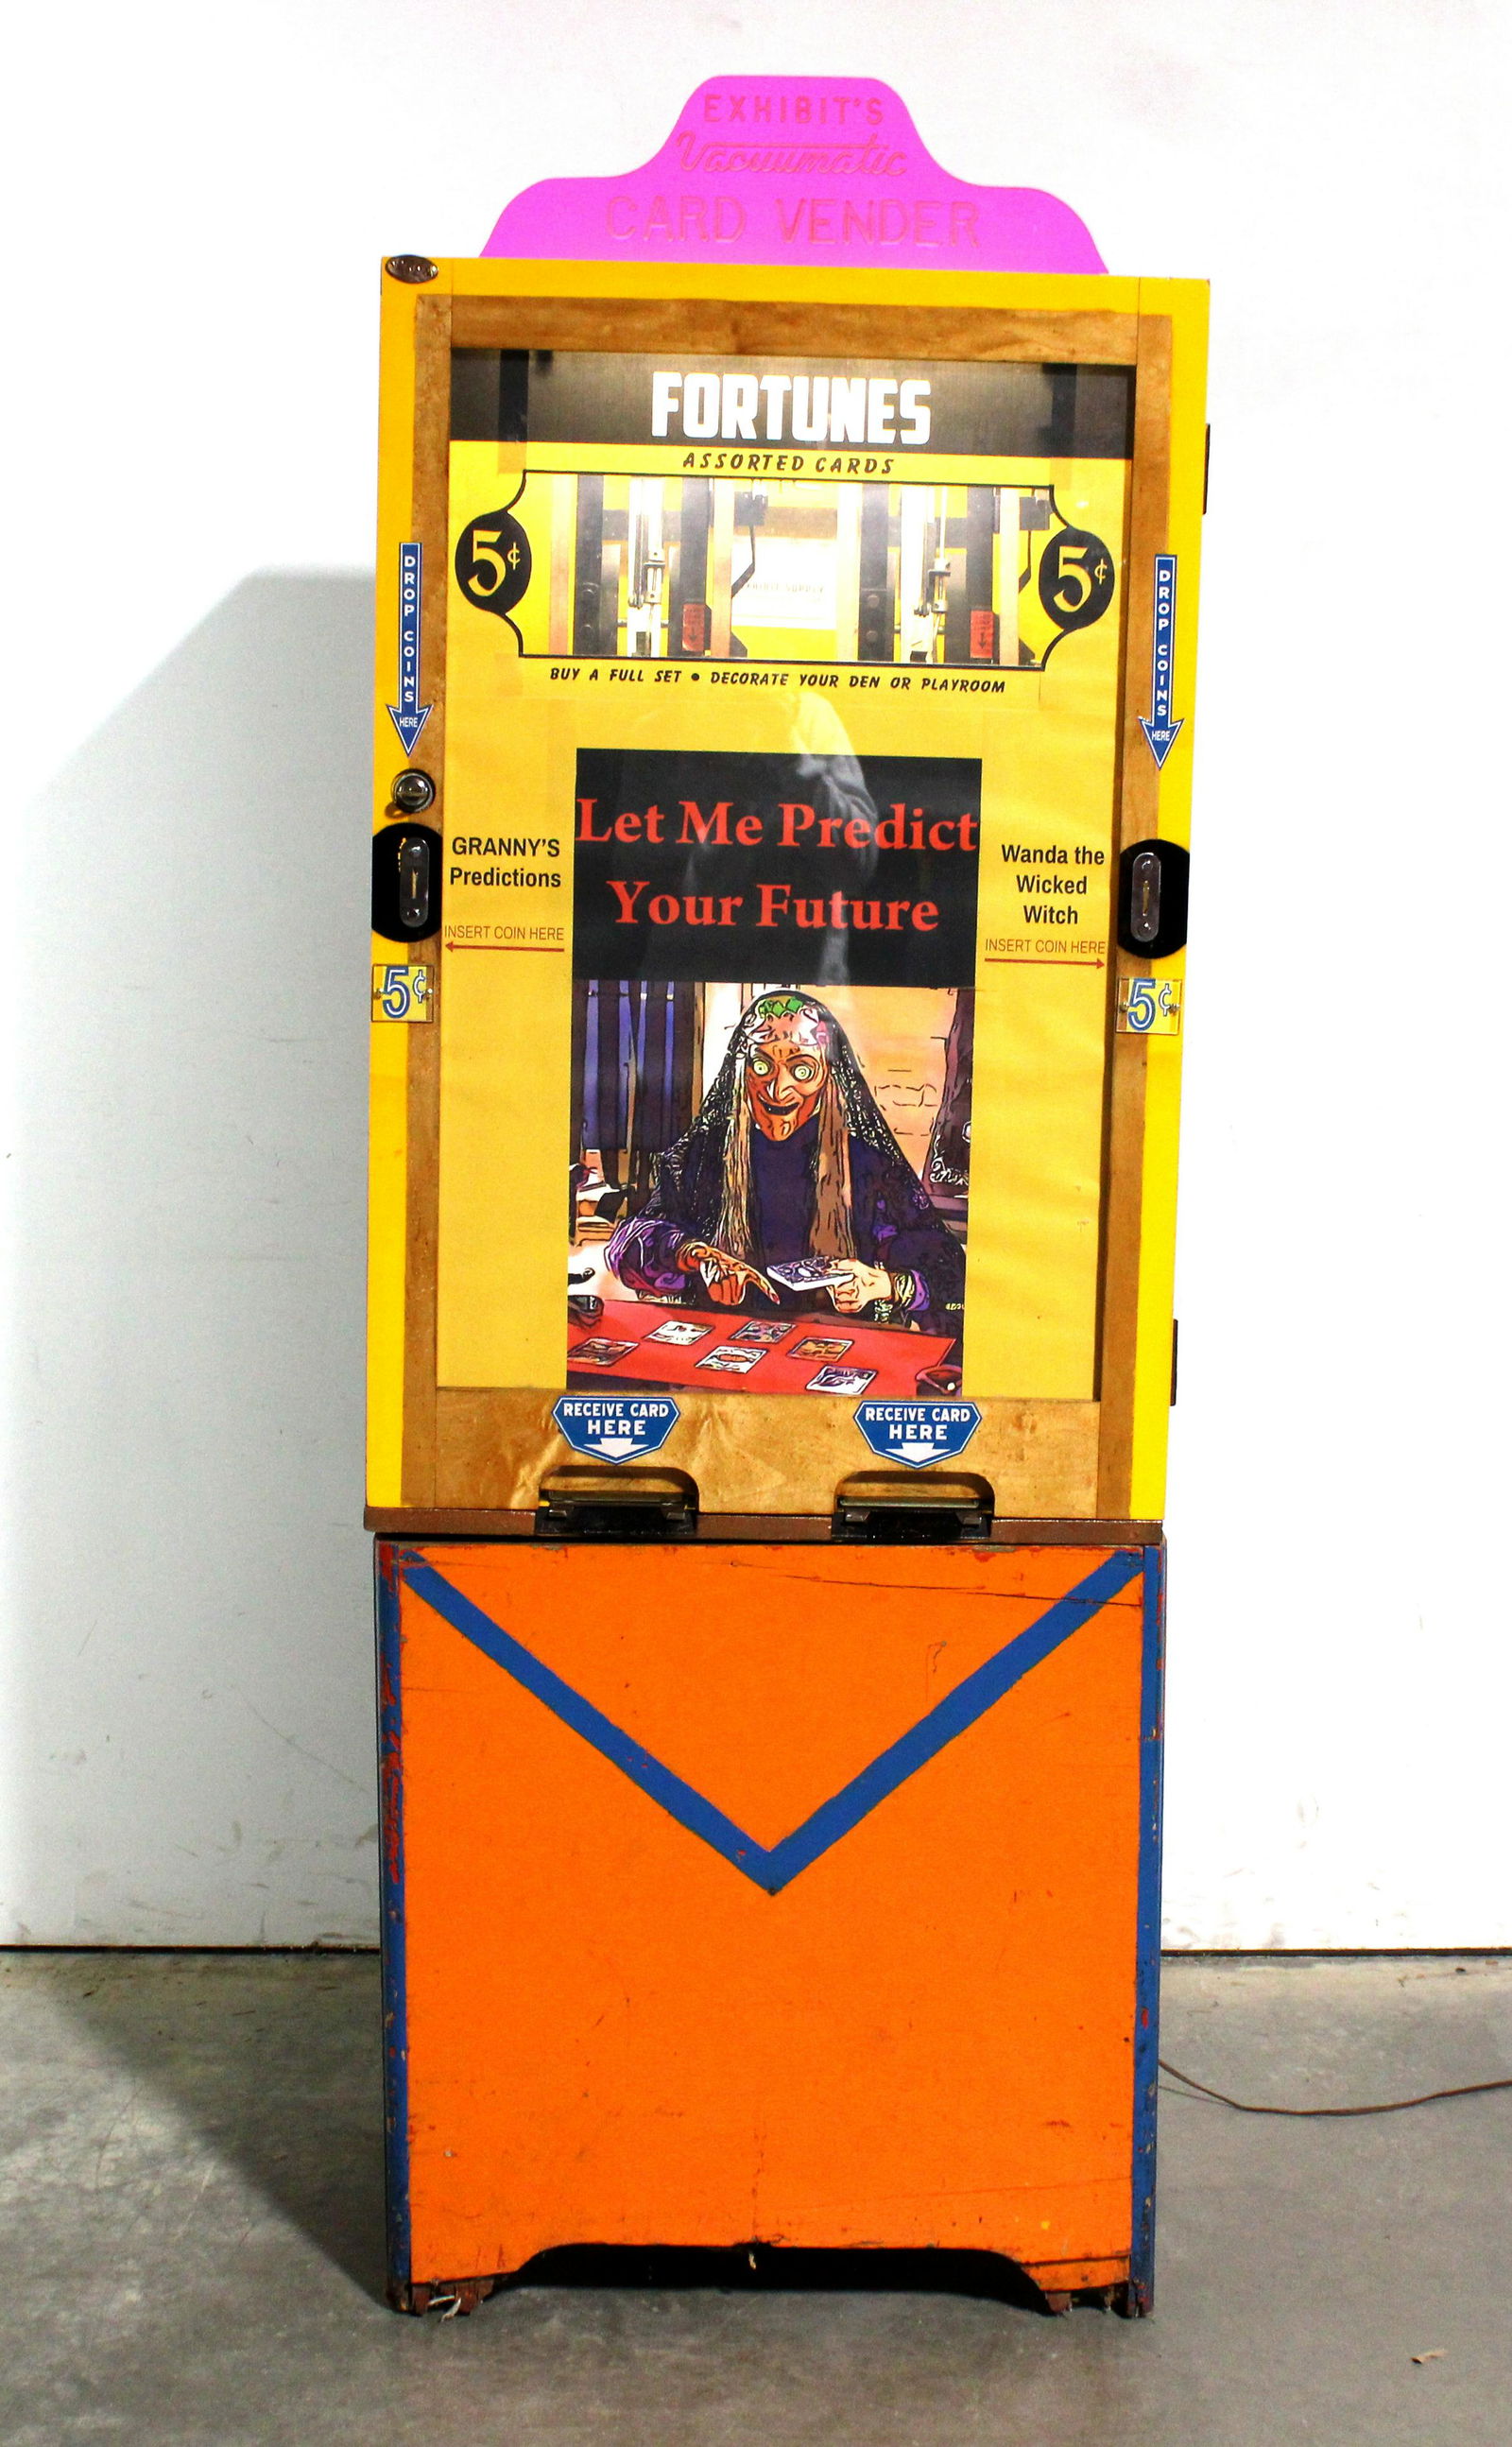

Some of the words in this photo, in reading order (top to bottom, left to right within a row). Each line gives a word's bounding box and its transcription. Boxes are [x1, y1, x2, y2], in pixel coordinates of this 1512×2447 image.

[703, 94, 884, 125] EXHIBIT'S
[676, 129, 908, 176] Vacuumatic
[606, 195, 747, 243] CARD
[775, 198, 981, 248] VENDER
[651, 370, 932, 445] FORTUNES
[682, 452, 804, 473] ASSORTED
[815, 457, 894, 474] CARDS
[404, 555, 416, 616] DROP
[1159, 569, 1171, 630] DROP
[404, 629, 415, 702] COINS
[550, 667, 580, 681] BUY
[589, 669, 599, 681] A
[609, 669, 644, 682] FULL
[654, 669, 682, 683] SET
[710, 671, 789, 686] DECORATE
[799, 673, 839, 688] YOUR
[849, 675, 881, 689] DEN
[890, 677, 912, 690] OR
[920, 678, 1005, 693] PLAYROOM
[1156, 644, 1168, 716] COINS
[399, 717, 418, 728] HERE
[1151, 731, 1170, 742] HERE
[576, 798, 664, 844] Let
[676, 801, 763, 846] Me
[777, 802, 977, 852] Predict
[1002, 844, 1068, 864] Wanda
[1074, 846, 1105, 865] the
[450, 867, 561, 887] Predictions
[1016, 874, 1087, 894] Wicked
[606, 880, 743, 925] Your
[756, 884, 939, 932] Future
[1023, 905, 1078, 924] Witch
[444, 924, 490, 939] INSERT
[494, 926, 525, 939] COIN
[530, 927, 564, 940] HERE
[985, 938, 1031, 952] INSERT
[1036, 939, 1067, 953] COIN
[1072, 940, 1106, 955] HERE
[563, 1403, 624, 1416] RECEIVE
[630, 1404, 669, 1418] CARD
[865, 1407, 926, 1422] RECEIVE
[932, 1408, 971, 1422] CARD
[588, 1420, 646, 1436] HERE
[889, 1424, 948, 1440] HERE
